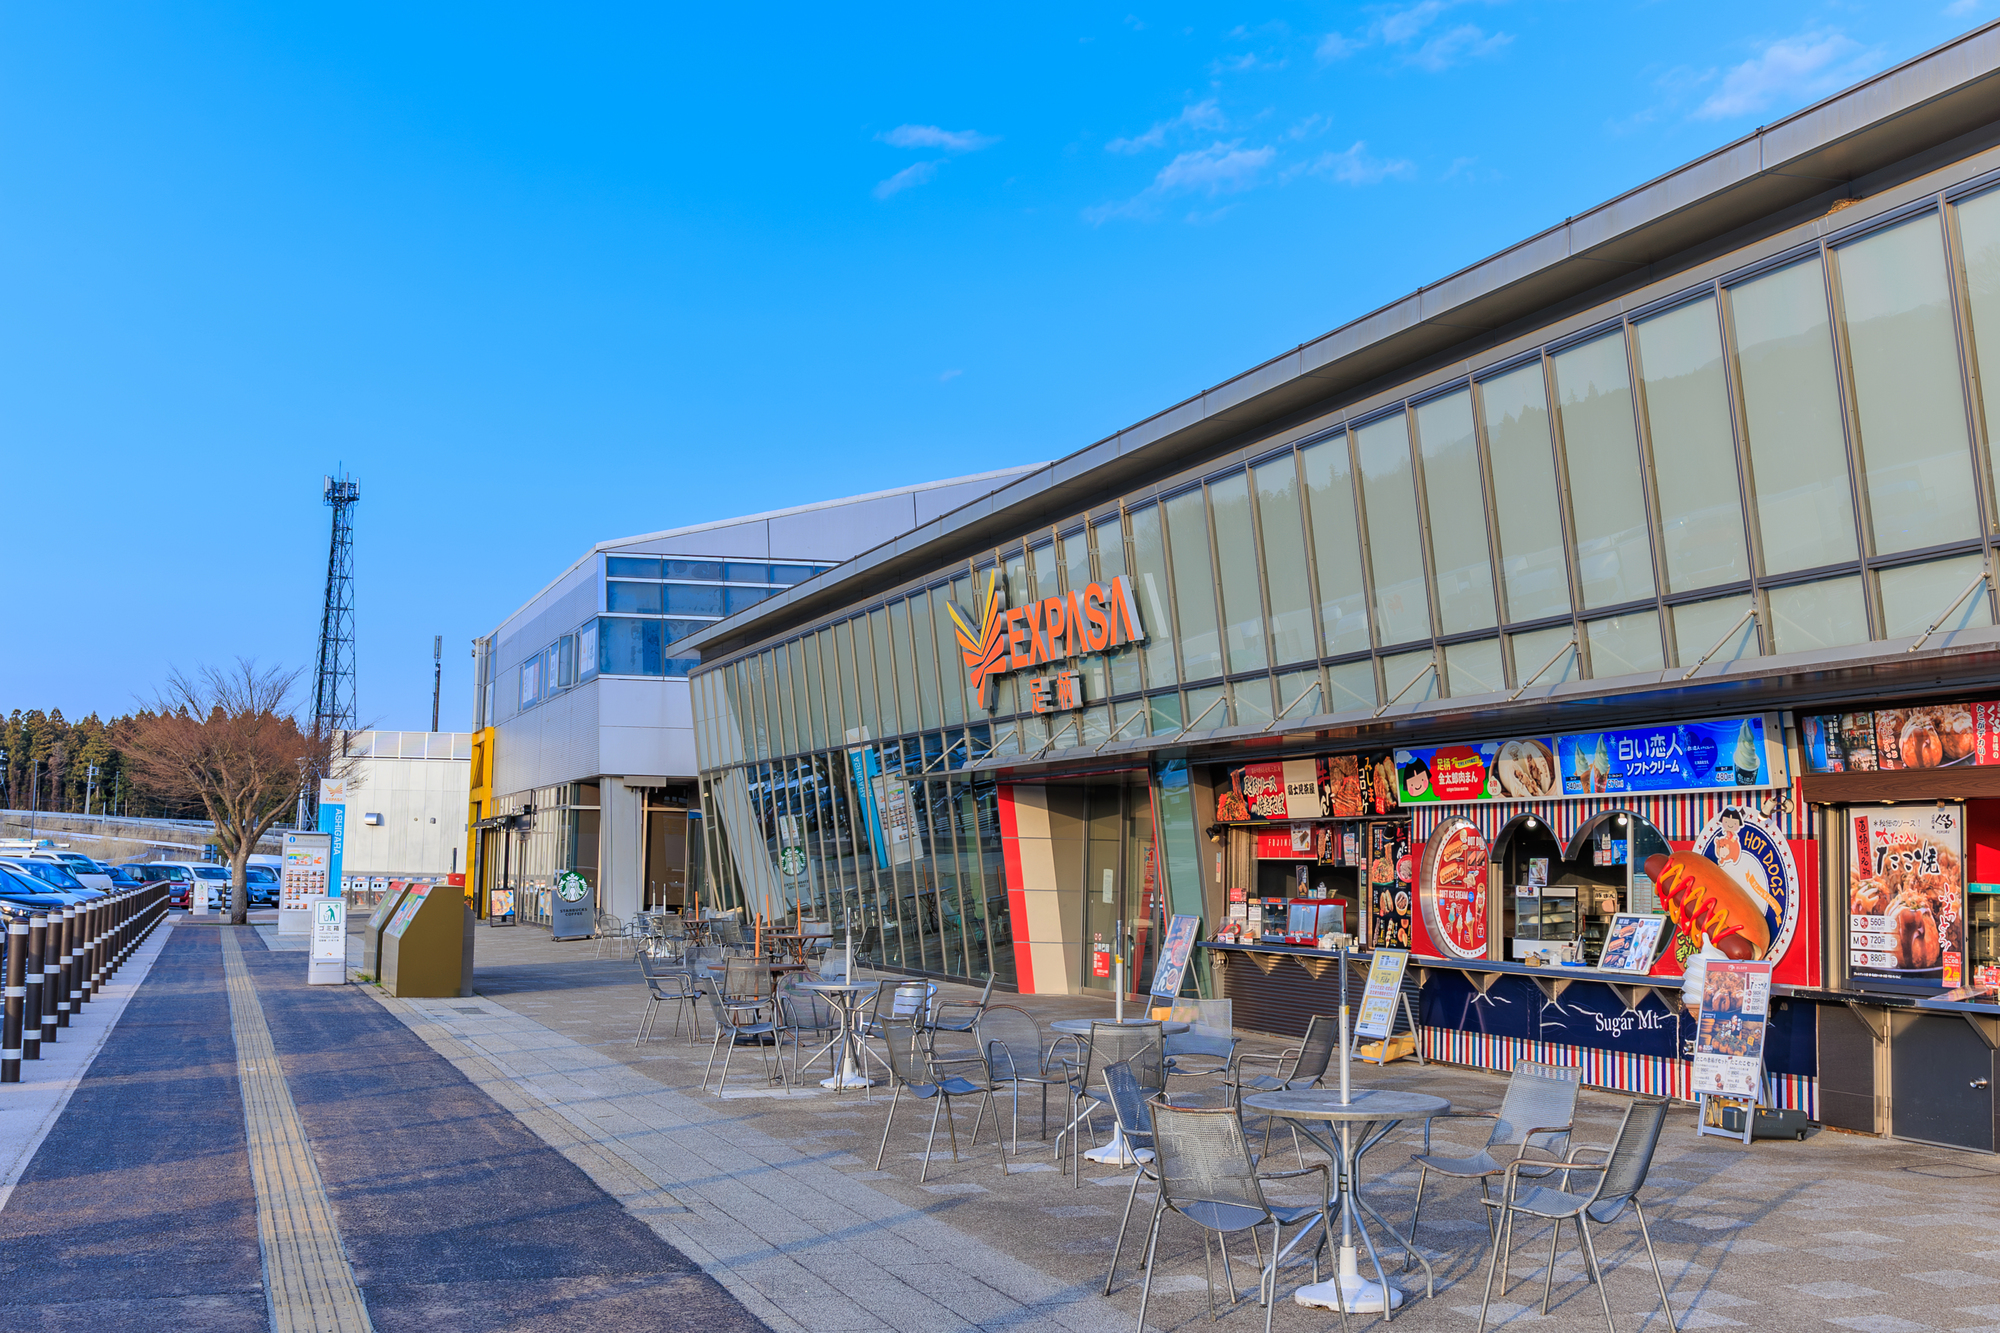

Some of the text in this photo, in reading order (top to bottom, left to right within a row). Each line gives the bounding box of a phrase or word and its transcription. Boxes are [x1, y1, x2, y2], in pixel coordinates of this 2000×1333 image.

[1006, 575, 1135, 669] EXPASA
[1029, 670, 1074, 714] 足柄
[1618, 733, 1683, 760] 白い恋人
[1365, 757, 1375, 802] みしま
[1438, 771, 1478, 785] 金太郎肉まん
[1626, 759, 1680, 776] ソフトクリーム
[1359, 768, 1368, 814] コロッケ
[333, 808, 344, 856] ASHIGARA
[1744, 830, 1785, 897] HOT DOGS
[1876, 840, 1940, 876] たこ焼
[1853, 918, 1859, 926] S
[1853, 936, 1860, 944] M
[1595, 1010, 1663, 1037] Sugar Mt.
